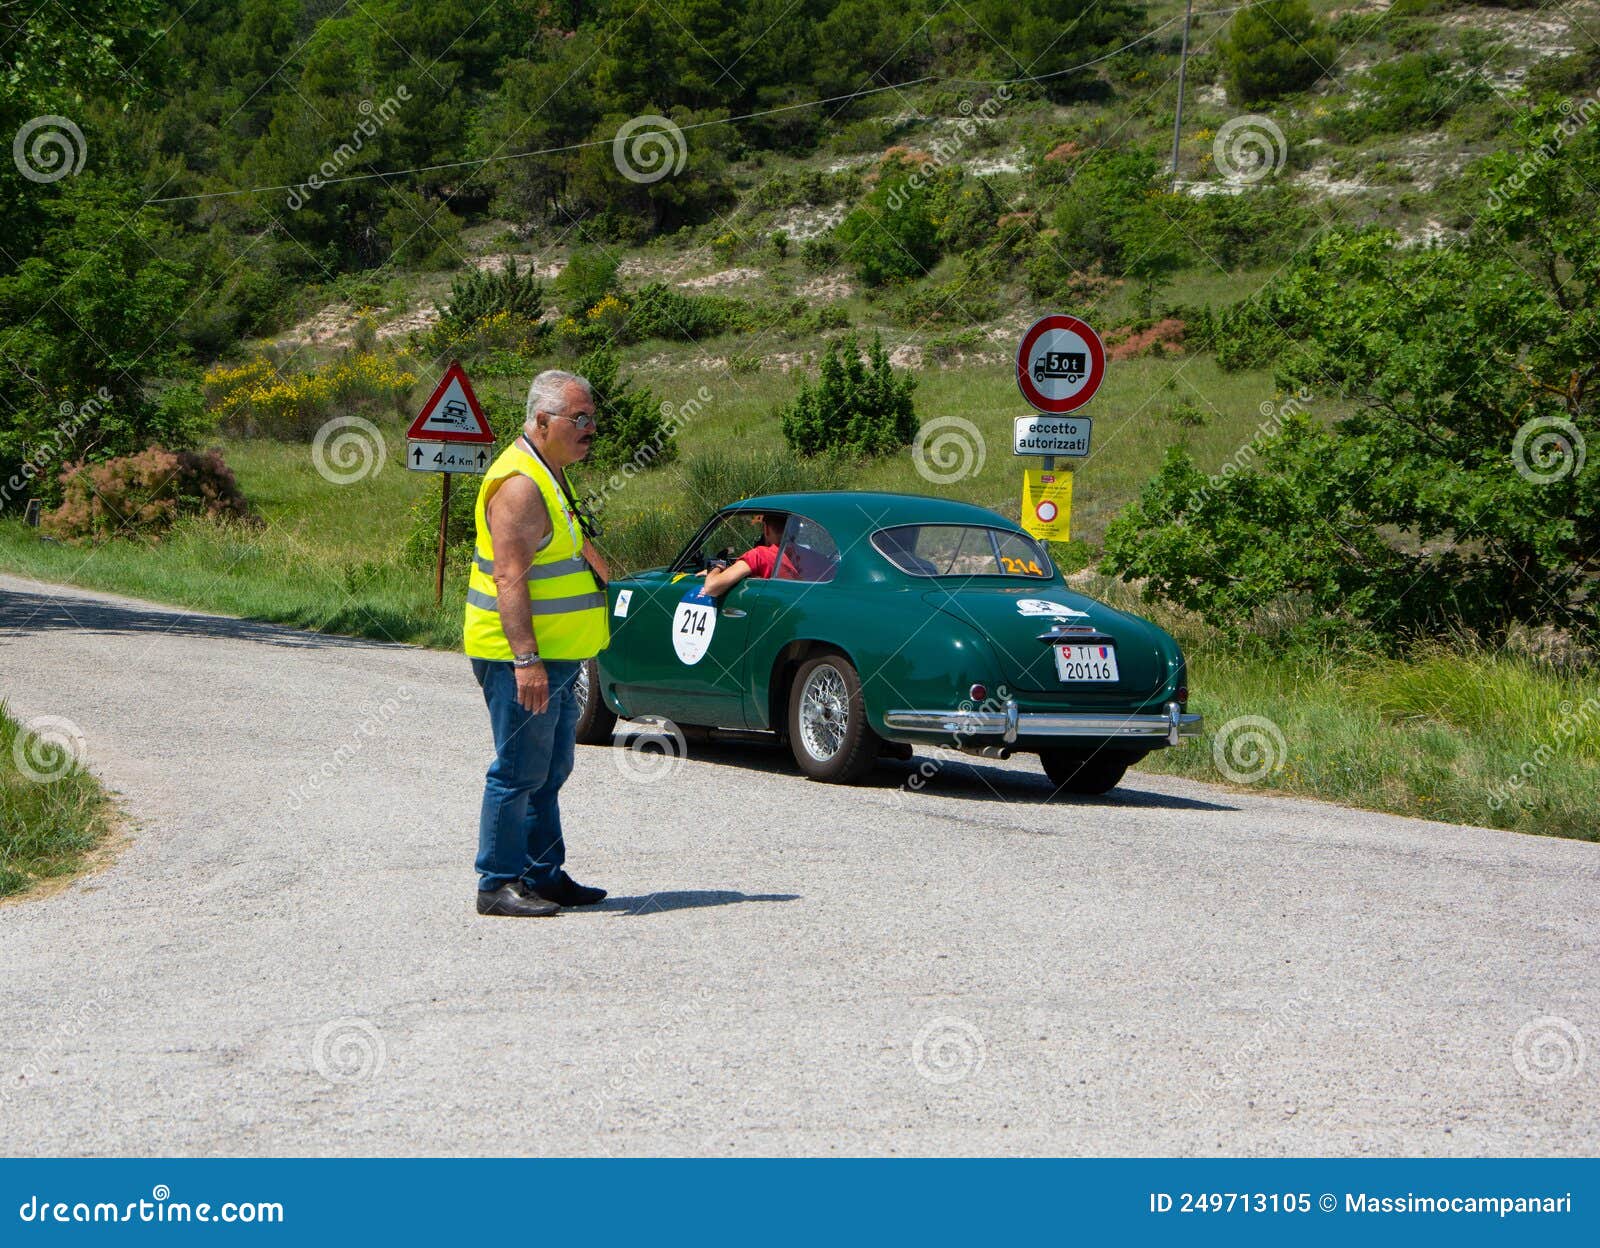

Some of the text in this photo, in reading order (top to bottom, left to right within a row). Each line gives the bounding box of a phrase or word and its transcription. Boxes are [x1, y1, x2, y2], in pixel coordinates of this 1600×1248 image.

[1072, 360, 1078, 370] t
[1029, 423, 1077, 435] eccetto
[1019, 438, 1086, 451] autorizzati
[433, 451, 473, 466] 4.4 Km
[1001, 557, 1043, 577] 214
[680, 609, 708, 636] 214
[1066, 662, 1111, 680] 20116
